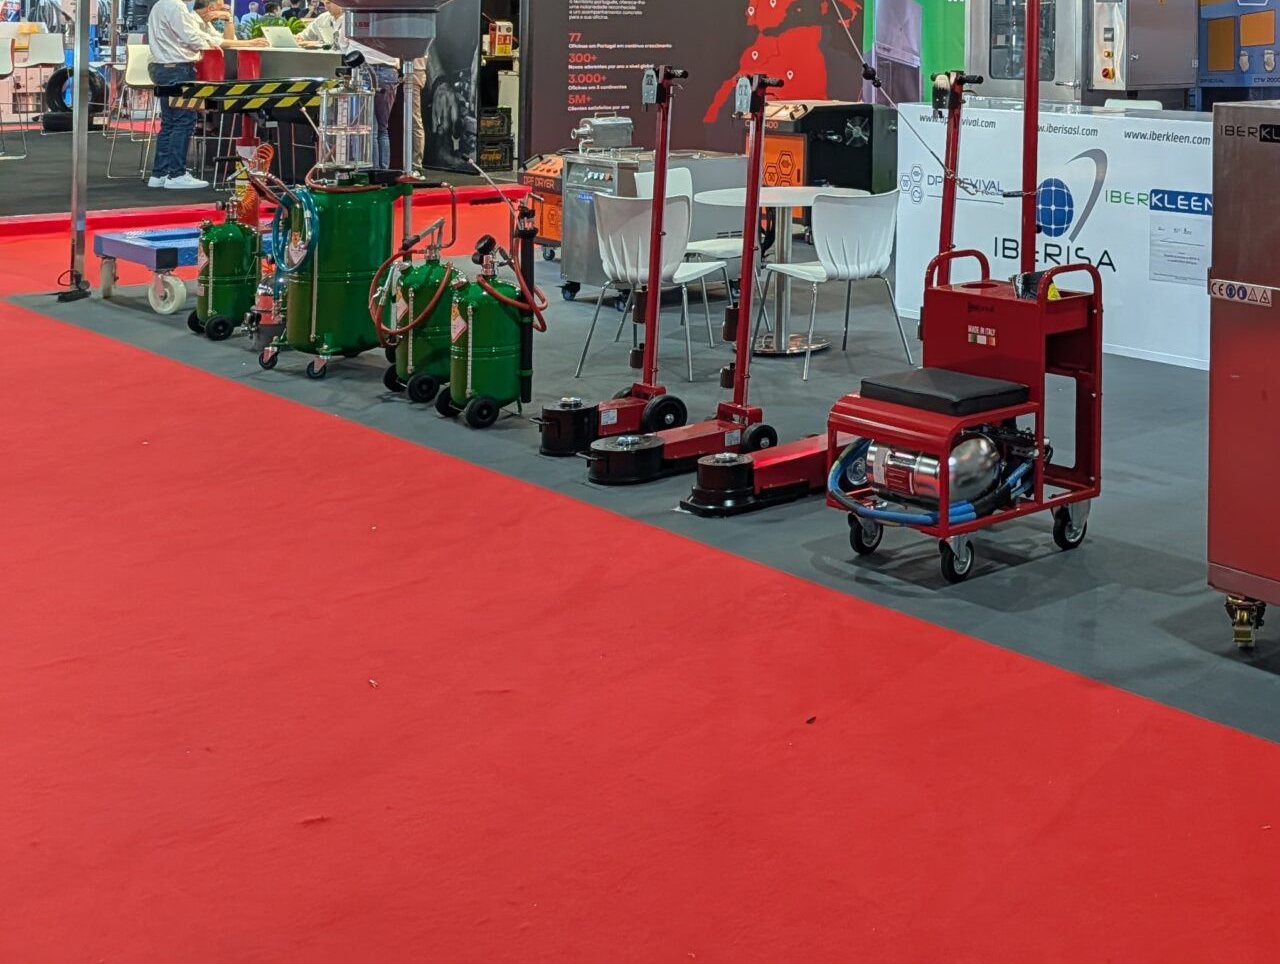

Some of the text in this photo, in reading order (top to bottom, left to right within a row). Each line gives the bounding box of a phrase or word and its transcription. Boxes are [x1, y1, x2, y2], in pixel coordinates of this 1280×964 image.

[568, 32, 582, 42] 77
[568, 53, 597, 63] 300+
[568, 74, 607, 83] 3.000+
[568, 95, 592, 104] 5M+
[1124, 130, 1211, 146] www.iberkleen.com
[535, 176, 555, 188] DRYER
[994, 237, 1116, 272] IBRISA
